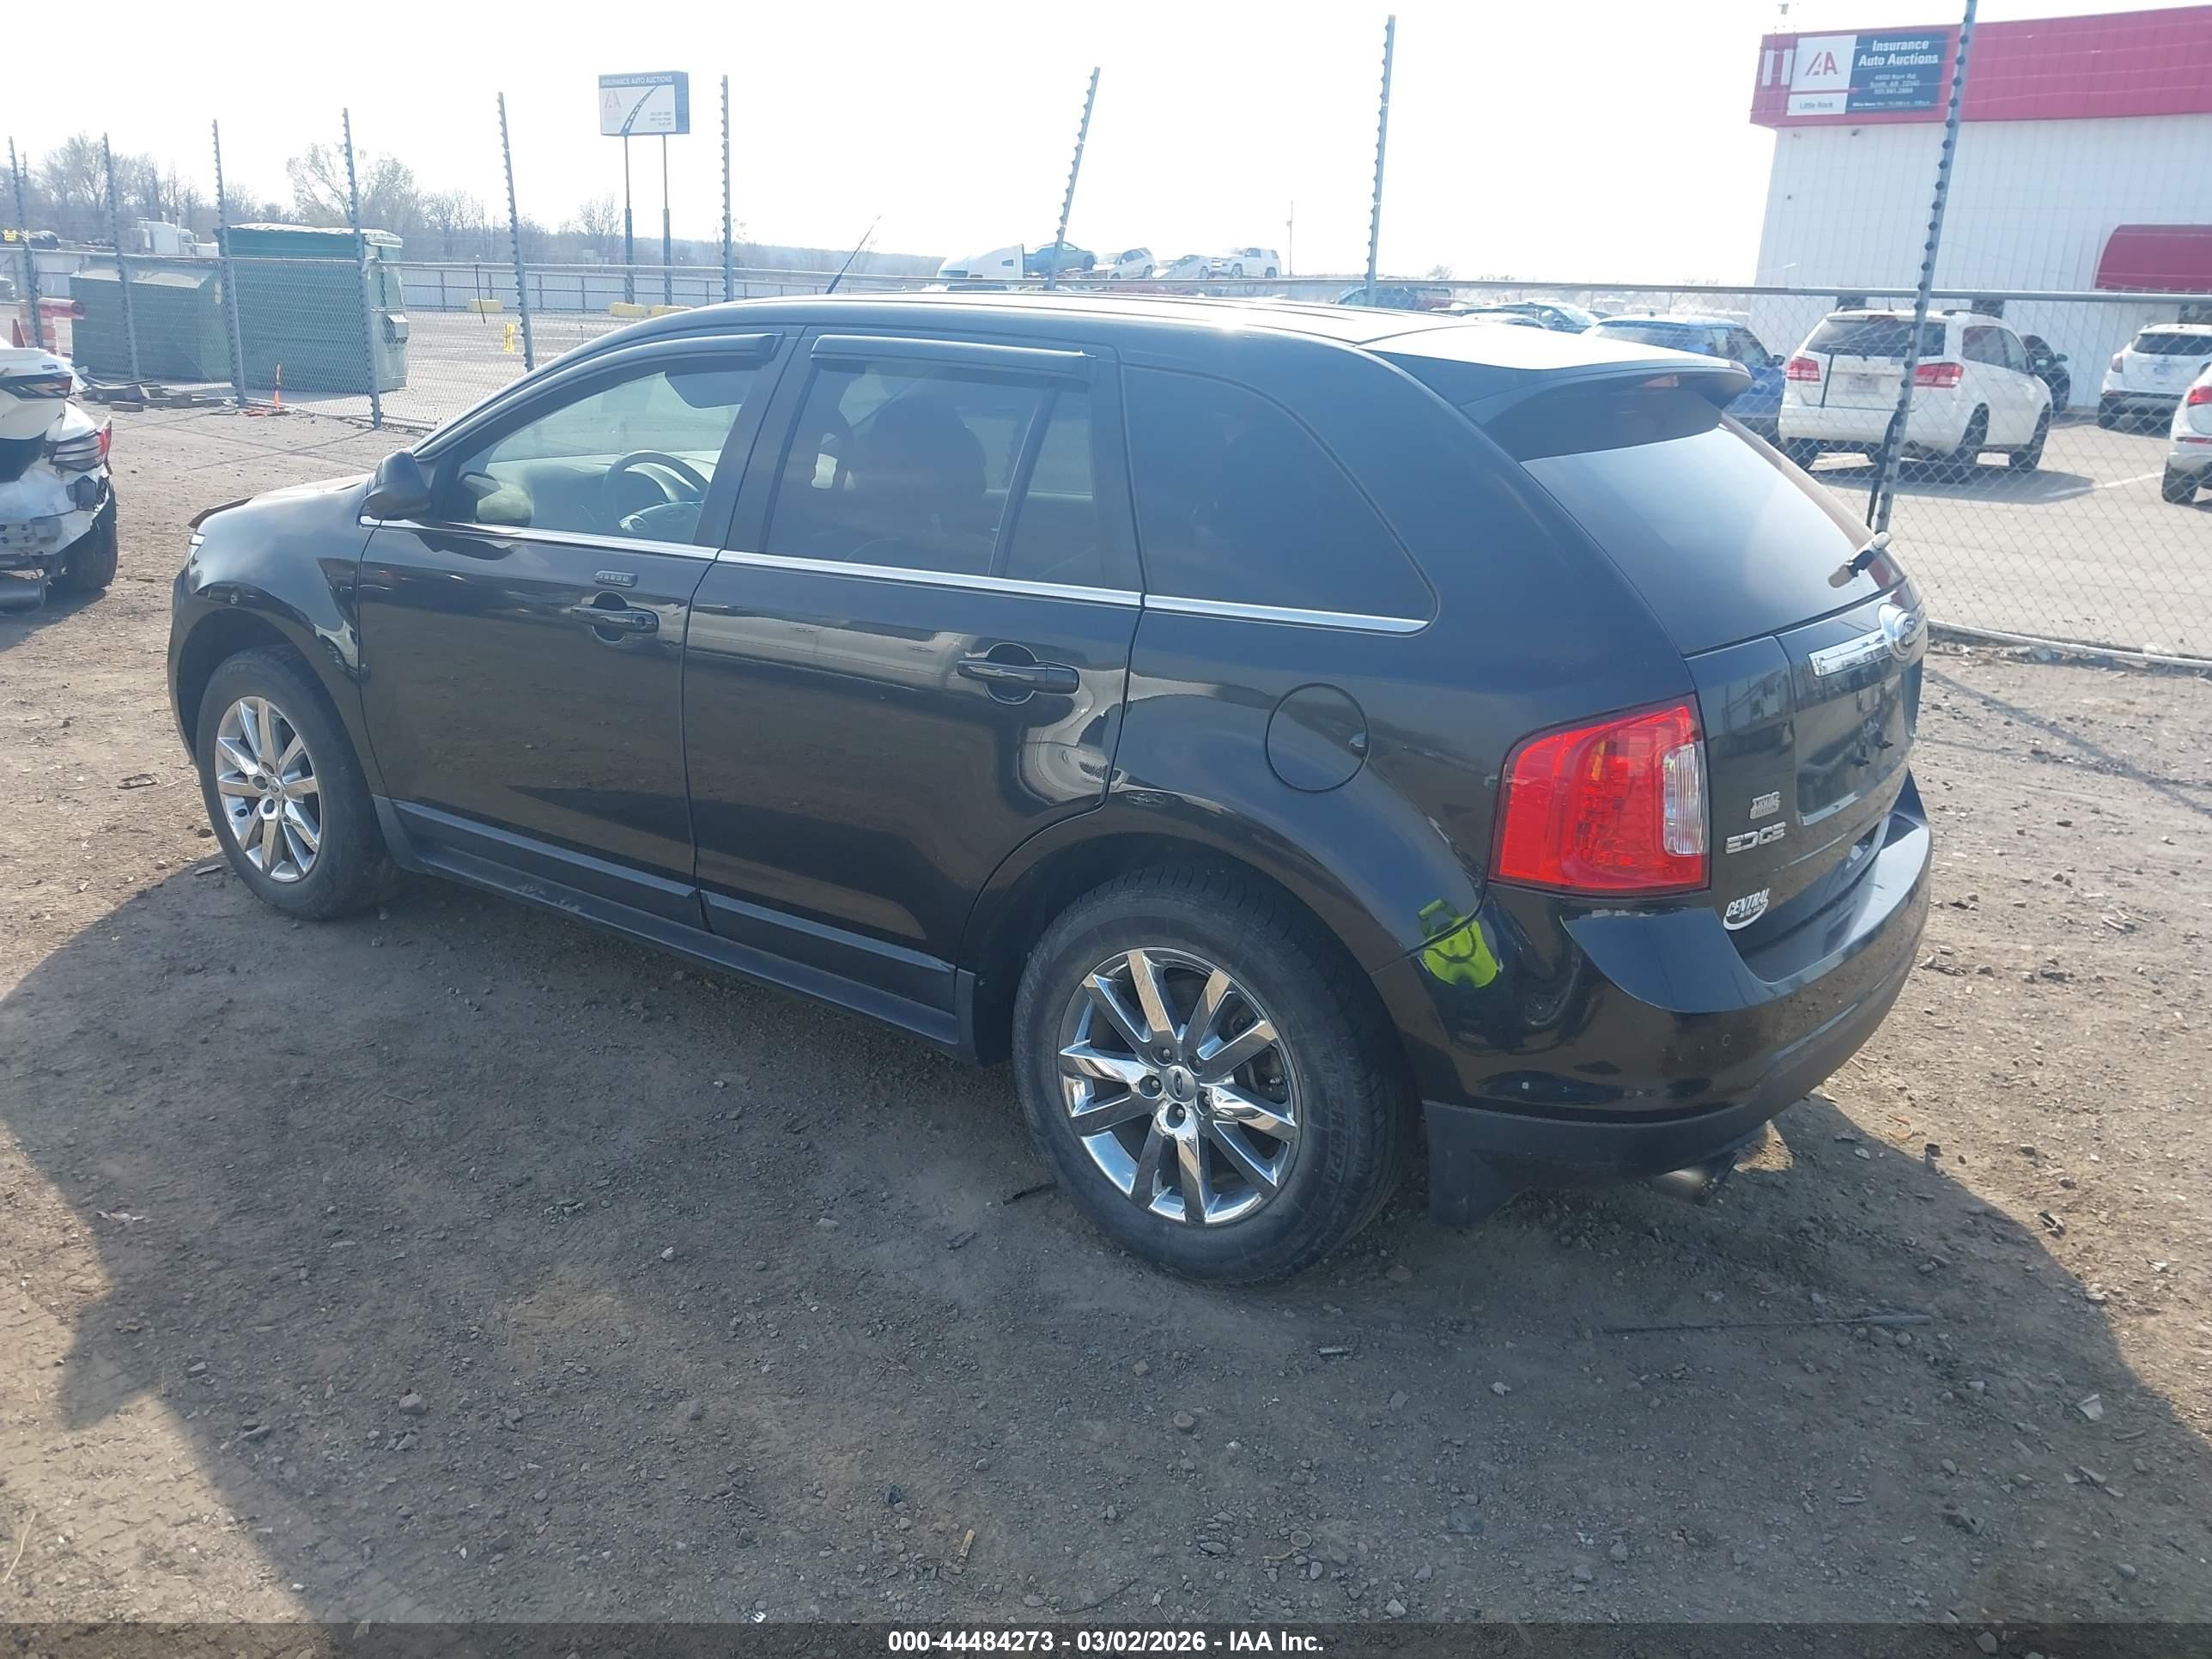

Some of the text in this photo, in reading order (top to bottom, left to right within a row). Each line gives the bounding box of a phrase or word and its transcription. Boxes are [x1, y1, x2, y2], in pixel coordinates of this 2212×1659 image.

[1873, 40, 1929, 52] Insurance
[1858, 52, 1938, 66] Auto Auctions
[1726, 821, 1786, 854] EDGE
[1726, 887, 1770, 917] CENTRAL
